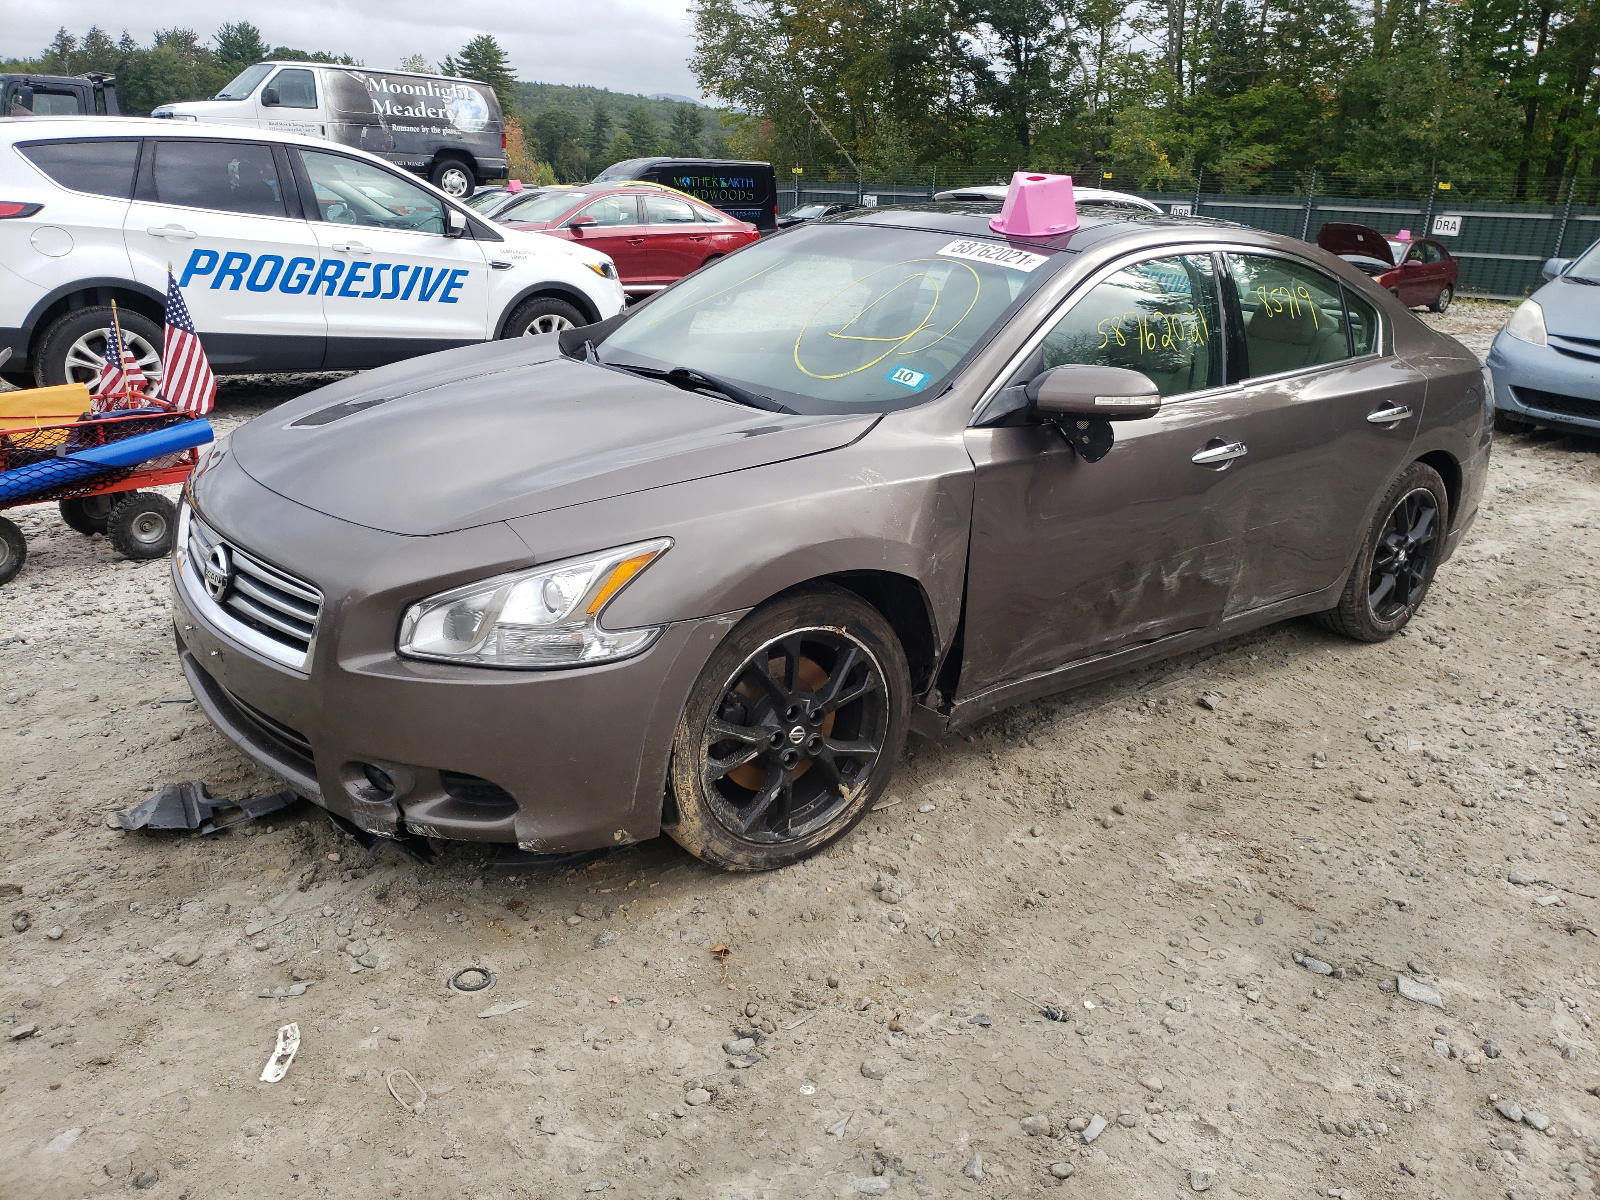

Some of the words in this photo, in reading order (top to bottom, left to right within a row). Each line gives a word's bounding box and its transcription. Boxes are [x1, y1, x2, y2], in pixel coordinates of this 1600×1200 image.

[391, 123, 420, 133] Romance
[431, 125, 441, 134] the
[720, 177, 754, 188] EARTH
[1435, 220, 1457, 231] DRA
[179, 248, 469, 304] PROGRESSIVE
[894, 370, 914, 382] 10
